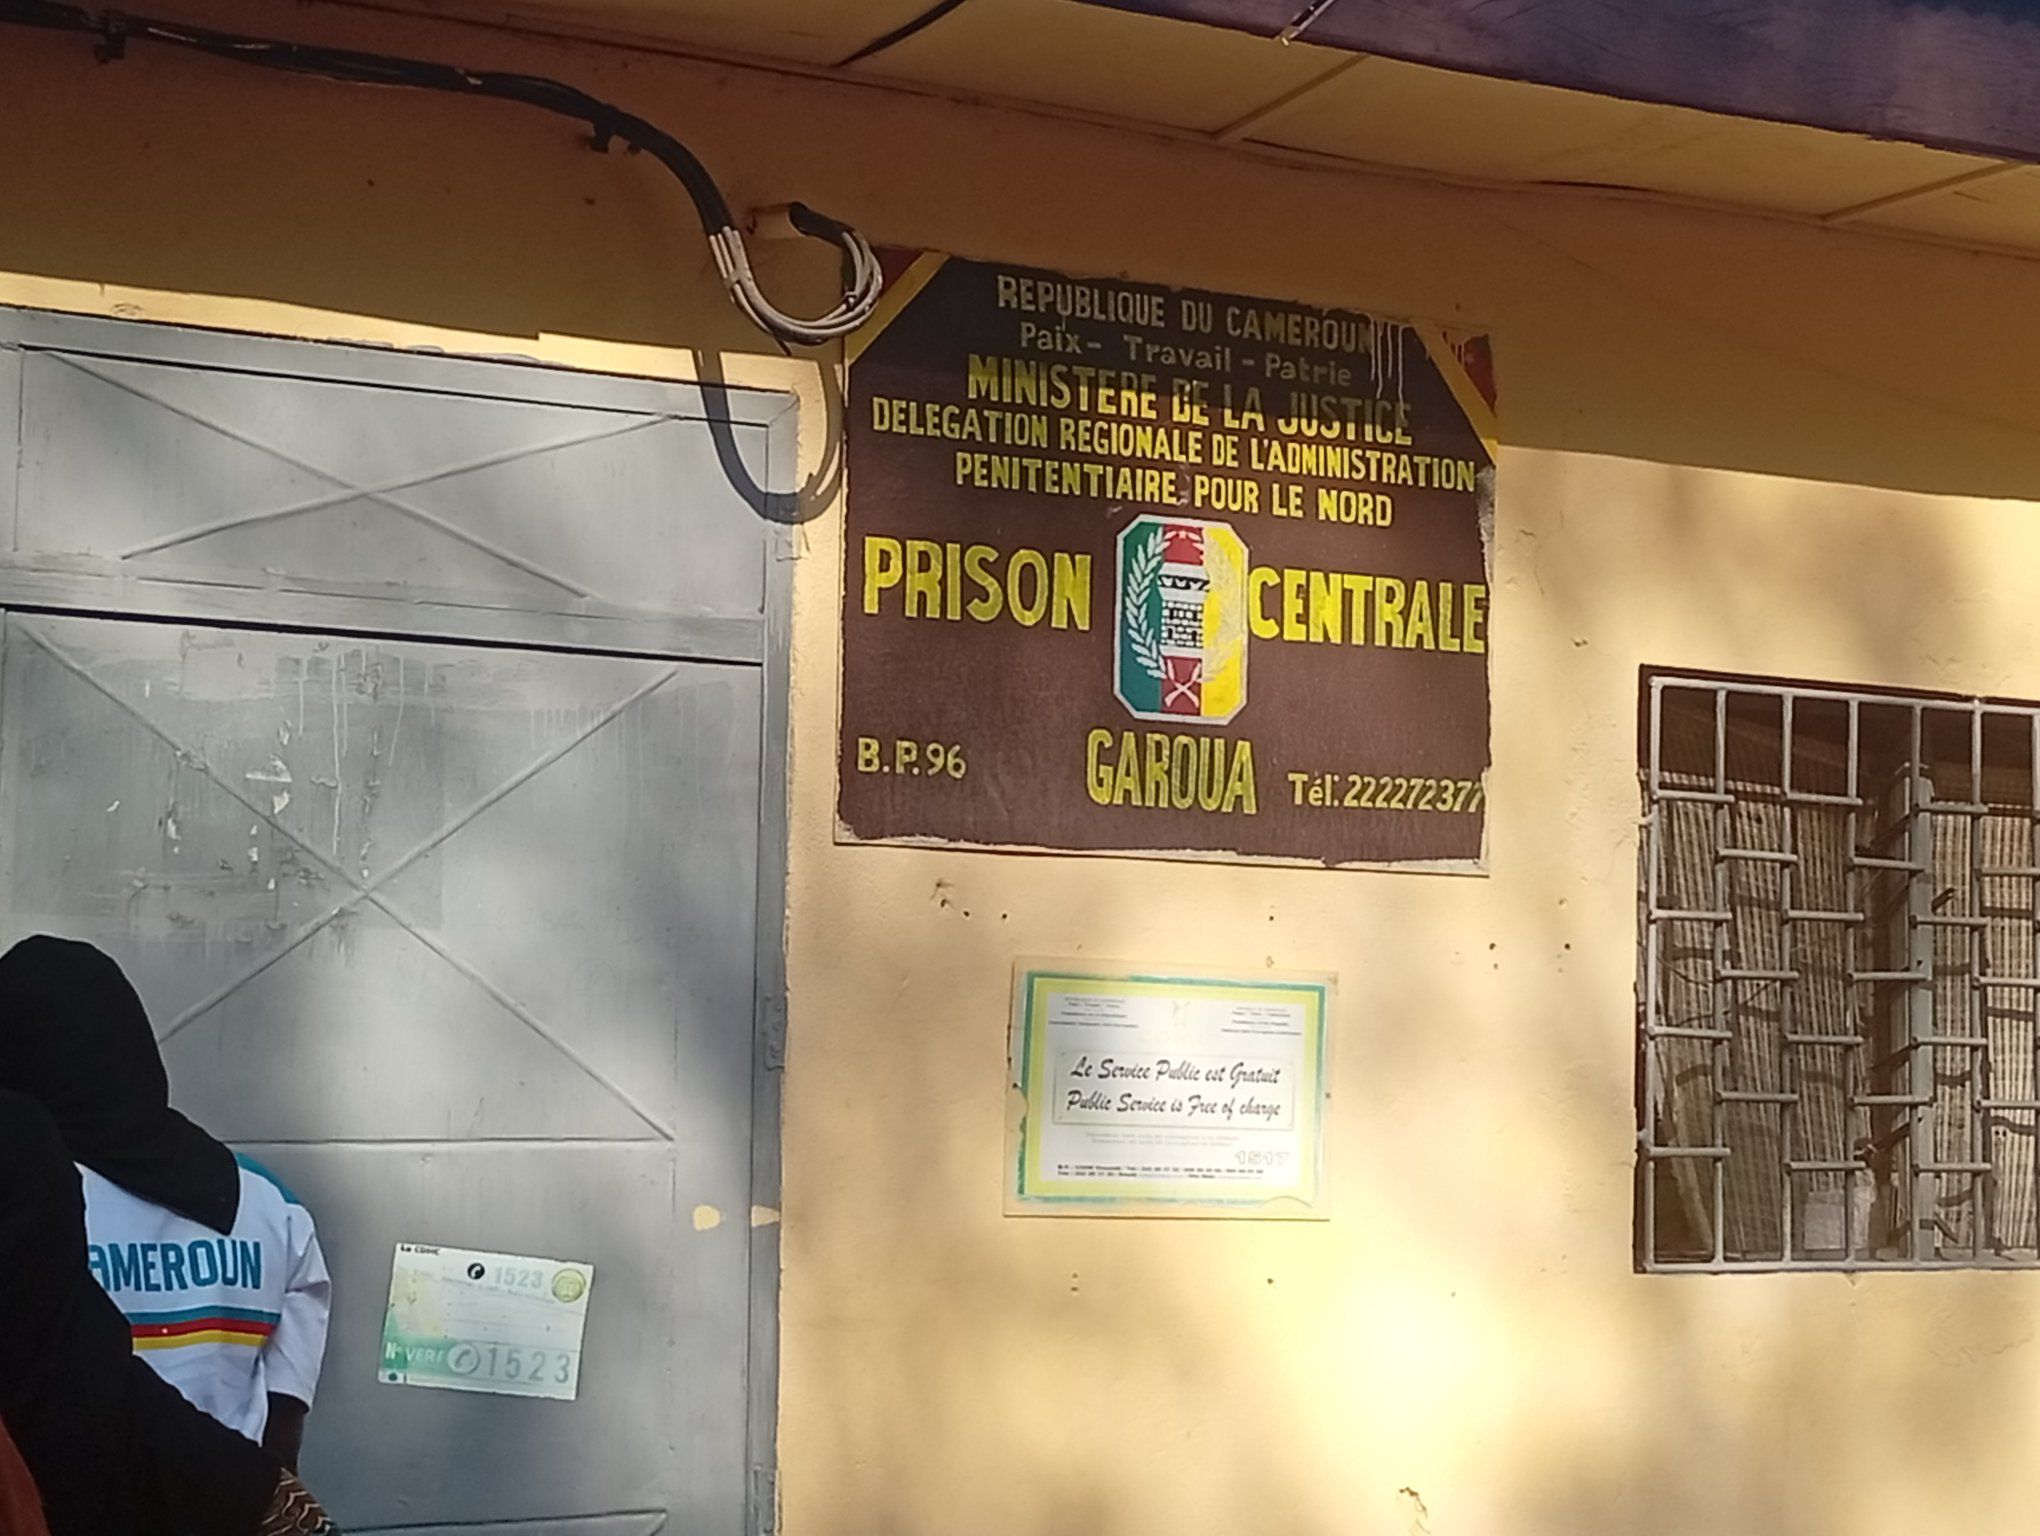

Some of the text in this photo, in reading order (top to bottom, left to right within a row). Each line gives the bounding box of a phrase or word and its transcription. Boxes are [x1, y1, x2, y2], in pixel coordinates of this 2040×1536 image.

[997, 275, 1374, 354] REPUBLIQUE DU CAMEROUN
[1123, 334, 1232, 372] Travail
[1265, 353, 1352, 387] Patrie
[968, 354, 1413, 445] MINISTERE DE LA JUSTICE
[872, 396, 1476, 492] DELEGATION REGIONALE DE L'ADMINISTRATION
[956, 451, 1393, 527] PENITENTIAIRE POUR LE NORD
[863, 536, 1486, 654] PRISON CENTRALE
[1086, 729, 1258, 815] GAROUA
[1070, 1056, 1281, 1089] Le Service Public est Gratuit
[1066, 1090, 1281, 1121] Public Service is Free of charge
[88, 1238, 262, 1293] AMEROUN
[494, 1265, 545, 1290] 1523
[488, 1346, 572, 1384] 1523
